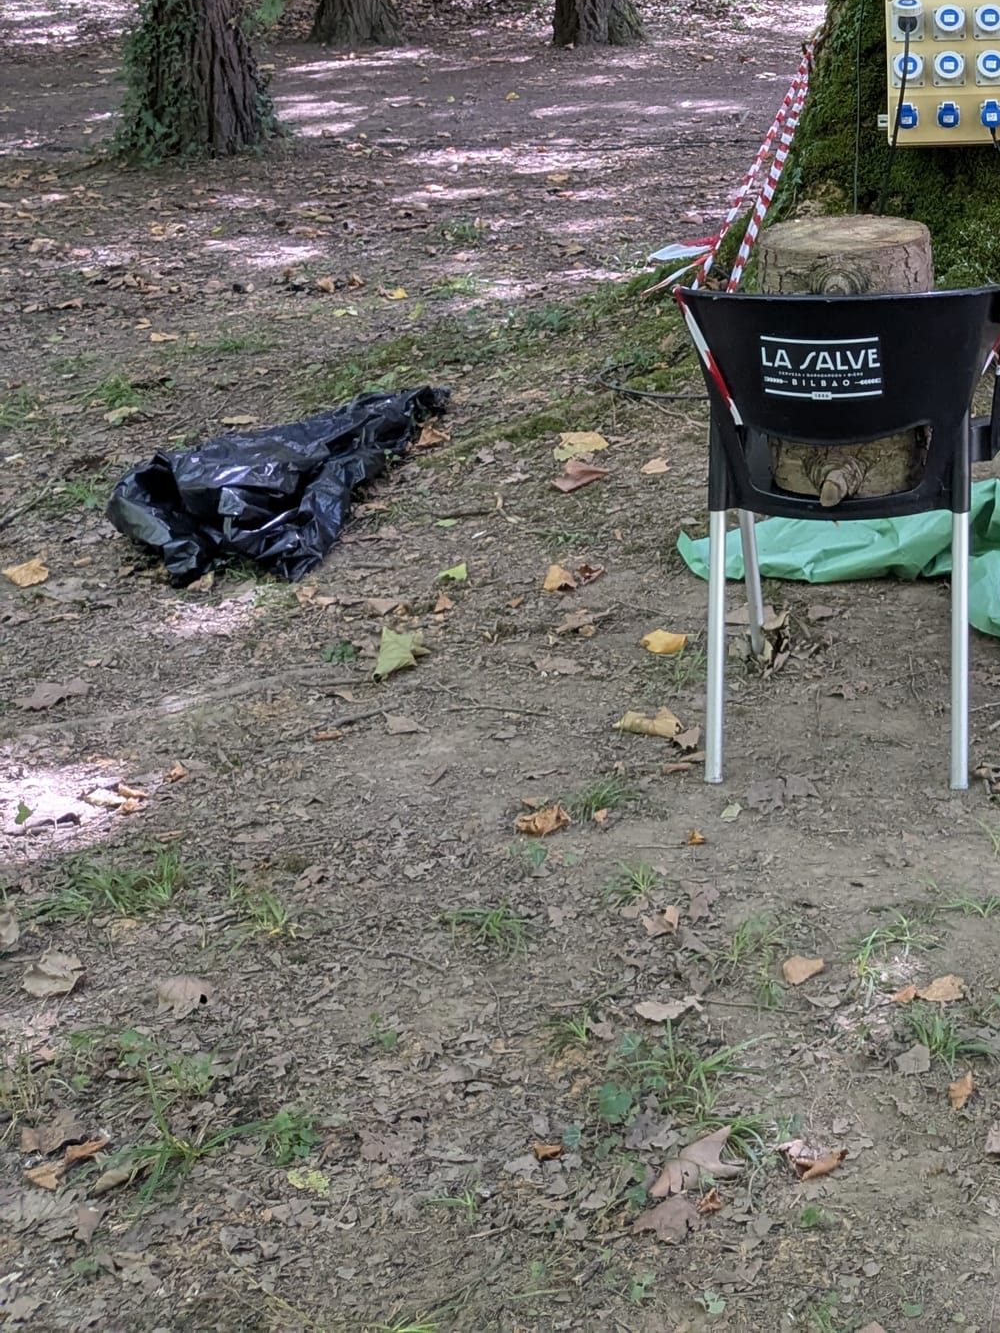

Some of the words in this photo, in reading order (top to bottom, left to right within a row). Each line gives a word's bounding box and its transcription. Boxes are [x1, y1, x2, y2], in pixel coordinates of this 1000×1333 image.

[761, 347, 792, 369] LA
[800, 348, 880, 370] SALVE
[792, 378, 850, 387] BILBAO
